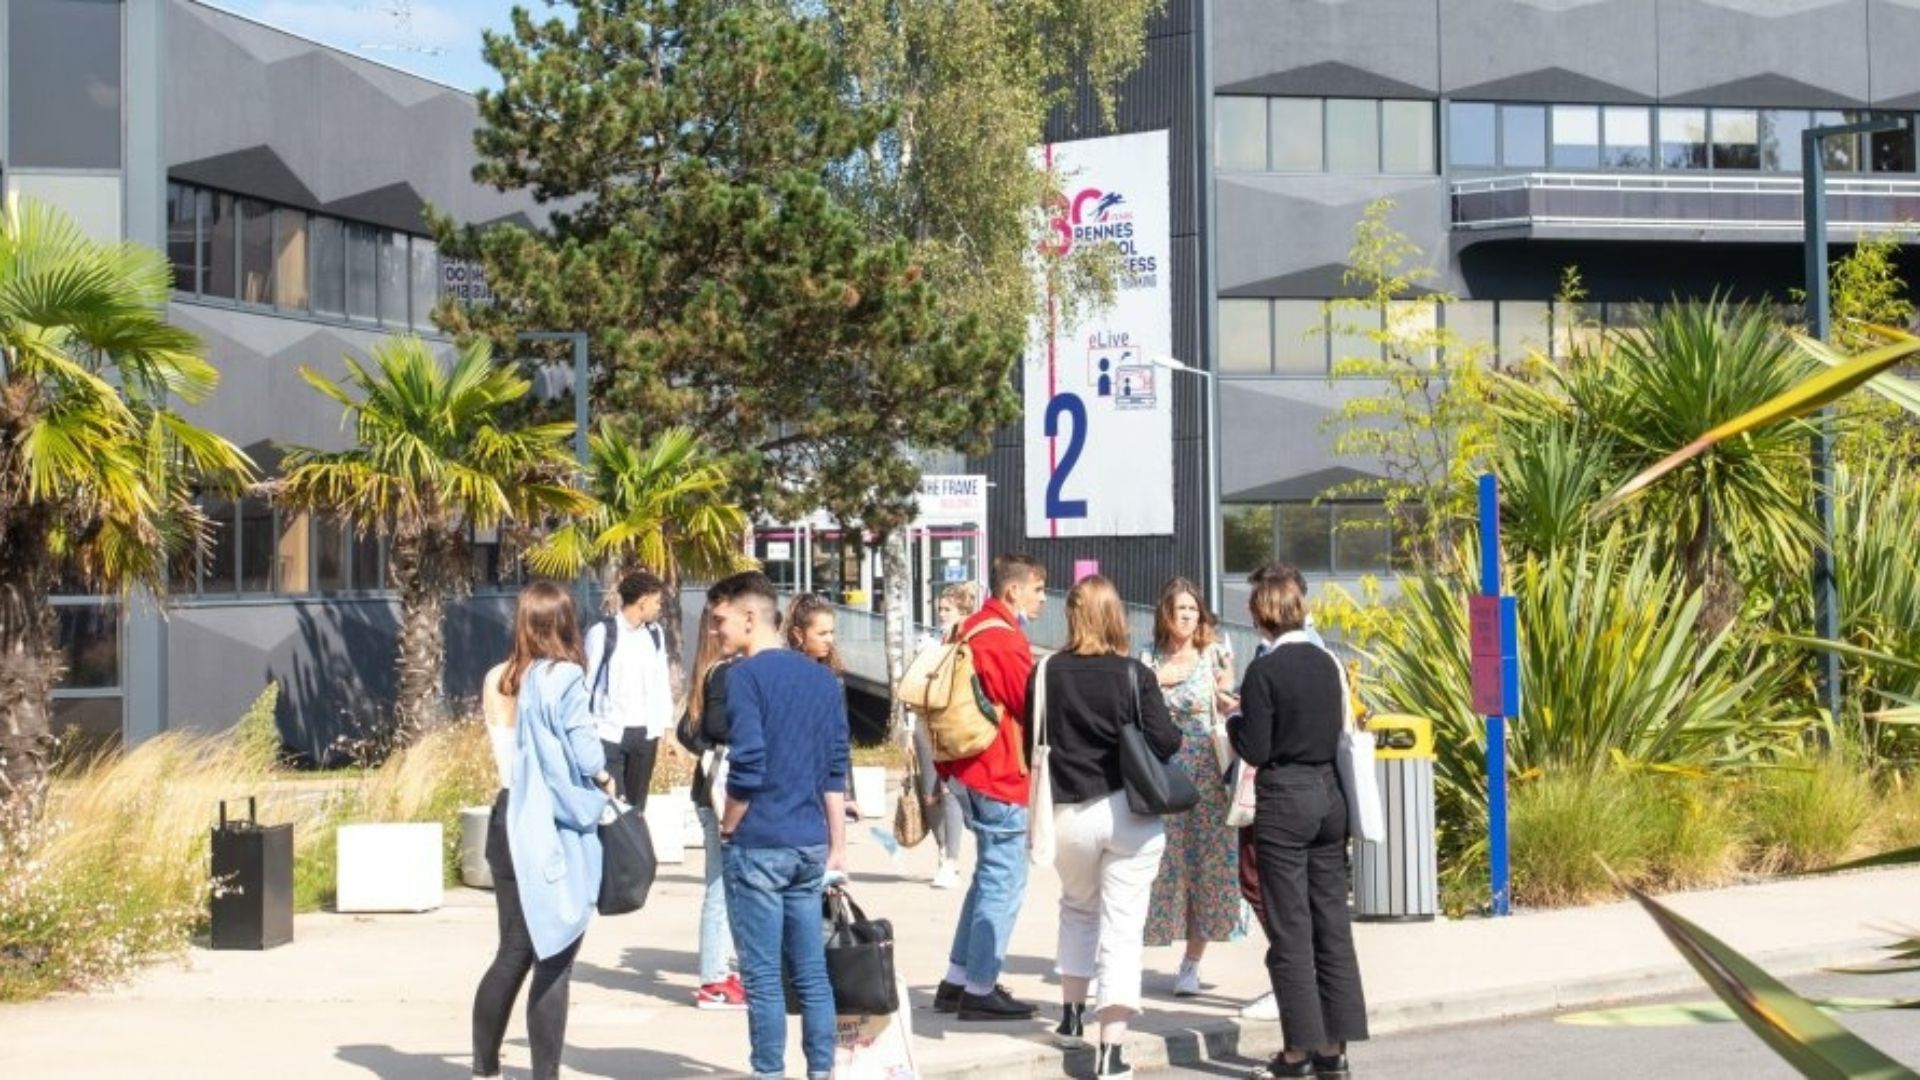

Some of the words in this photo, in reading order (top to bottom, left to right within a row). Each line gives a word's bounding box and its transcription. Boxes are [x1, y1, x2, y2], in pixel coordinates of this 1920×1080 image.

[1074, 222, 1134, 241] RENNES
[1089, 331, 1129, 348] eLive
[1044, 392, 1088, 518] 2
[942, 479, 978, 496] FRAME
